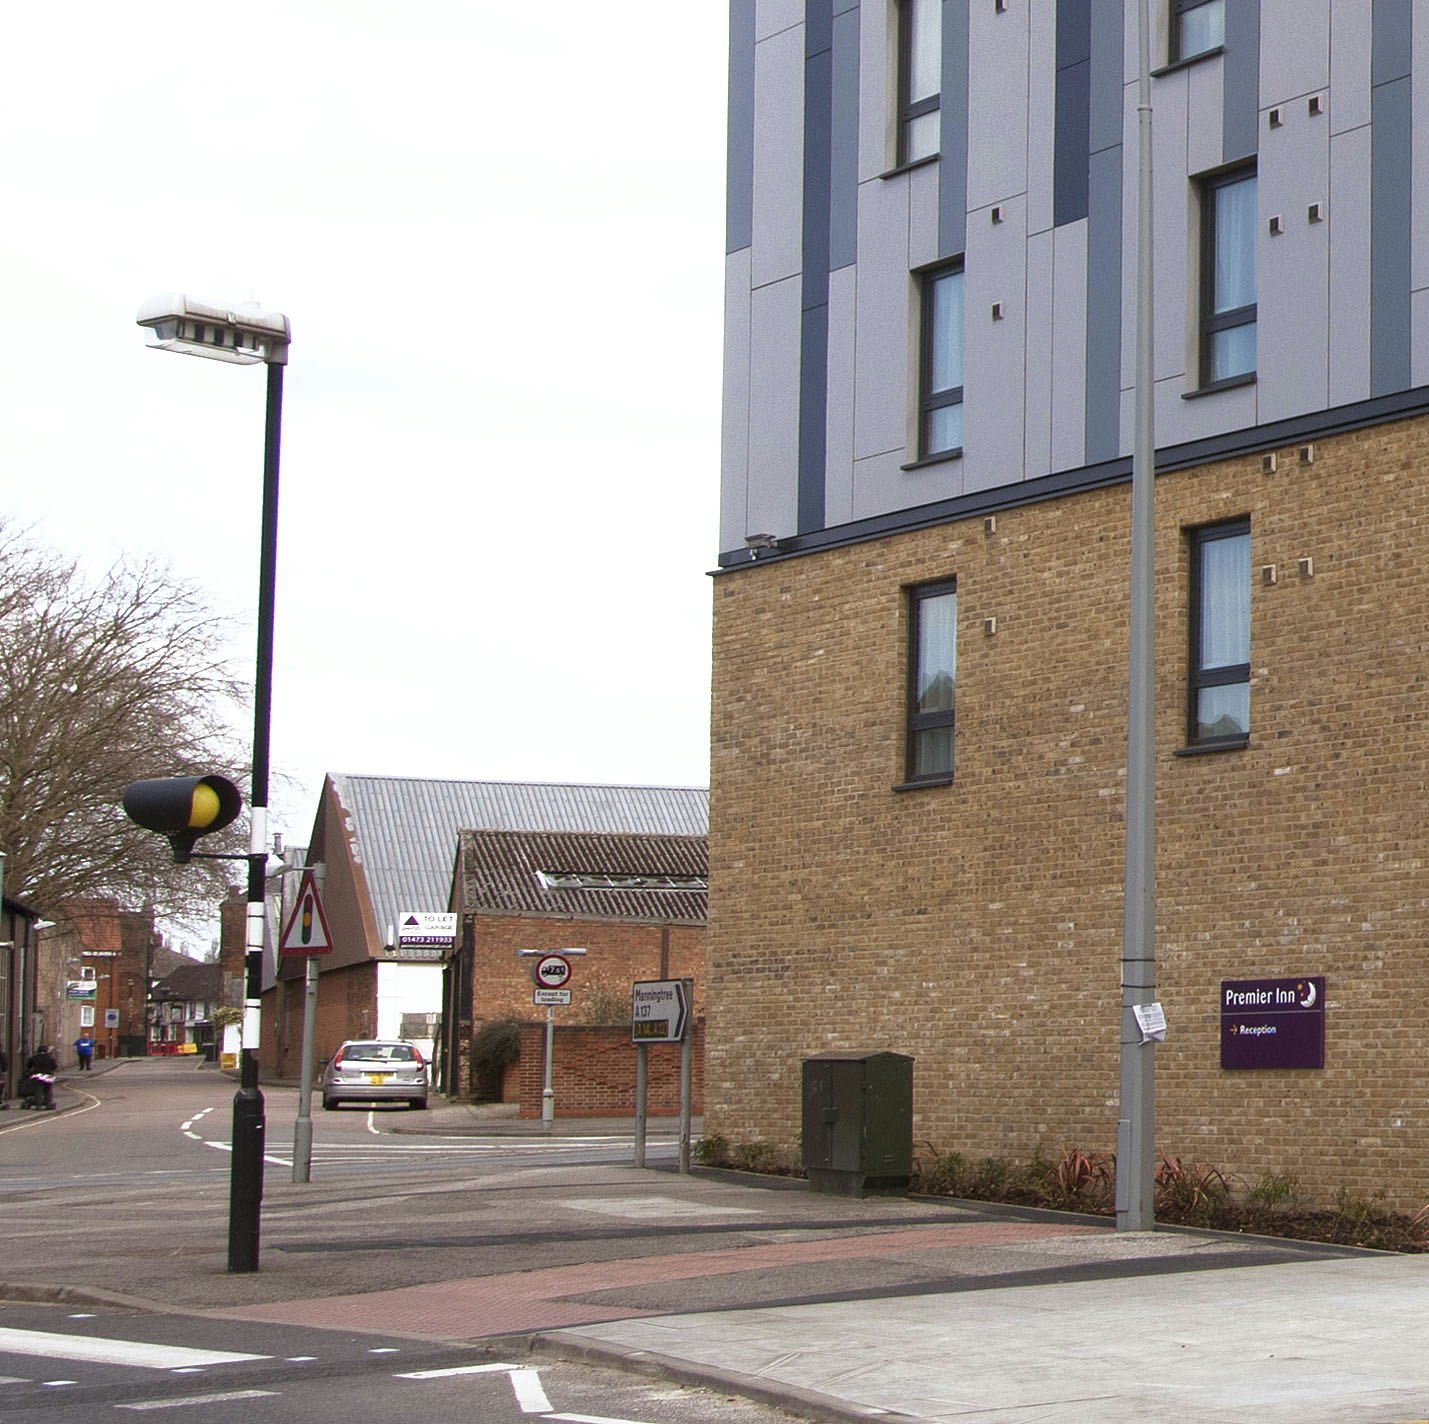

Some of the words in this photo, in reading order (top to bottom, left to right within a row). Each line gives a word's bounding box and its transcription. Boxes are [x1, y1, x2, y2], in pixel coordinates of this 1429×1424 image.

[1226, 989, 1273, 1006] Premier
[1276, 988, 1296, 1004] Inn
[1239, 1025, 1277, 1037] Reception
